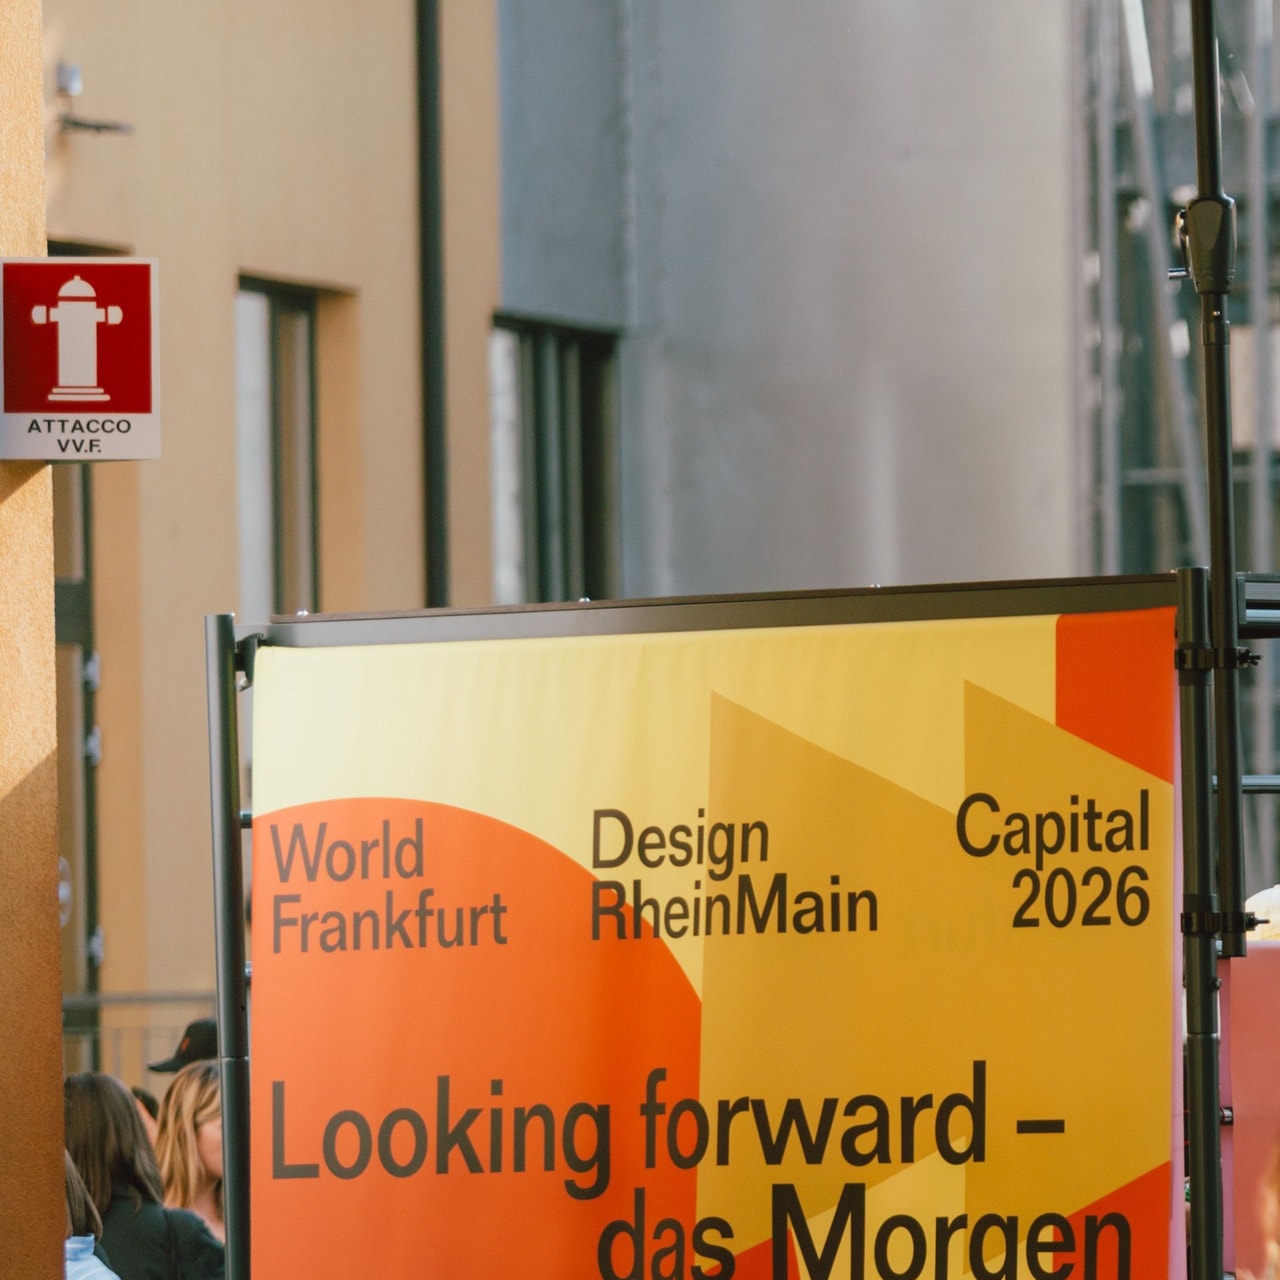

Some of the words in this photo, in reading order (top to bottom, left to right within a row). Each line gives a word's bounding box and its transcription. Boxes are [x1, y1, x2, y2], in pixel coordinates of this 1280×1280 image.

[27, 419, 132, 434] ATTACCO
[57, 439, 102, 453] VV.F.
[271, 817, 425, 883] World
[592, 808, 770, 882] Design
[957, 789, 1150, 872] Capital
[273, 887, 509, 954] Frankfurt
[592, 872, 879, 941] RheinMain
[1012, 865, 1151, 928] 2026
[271, 1074, 611, 1200] Looking
[640, 1060, 986, 1170] forward
